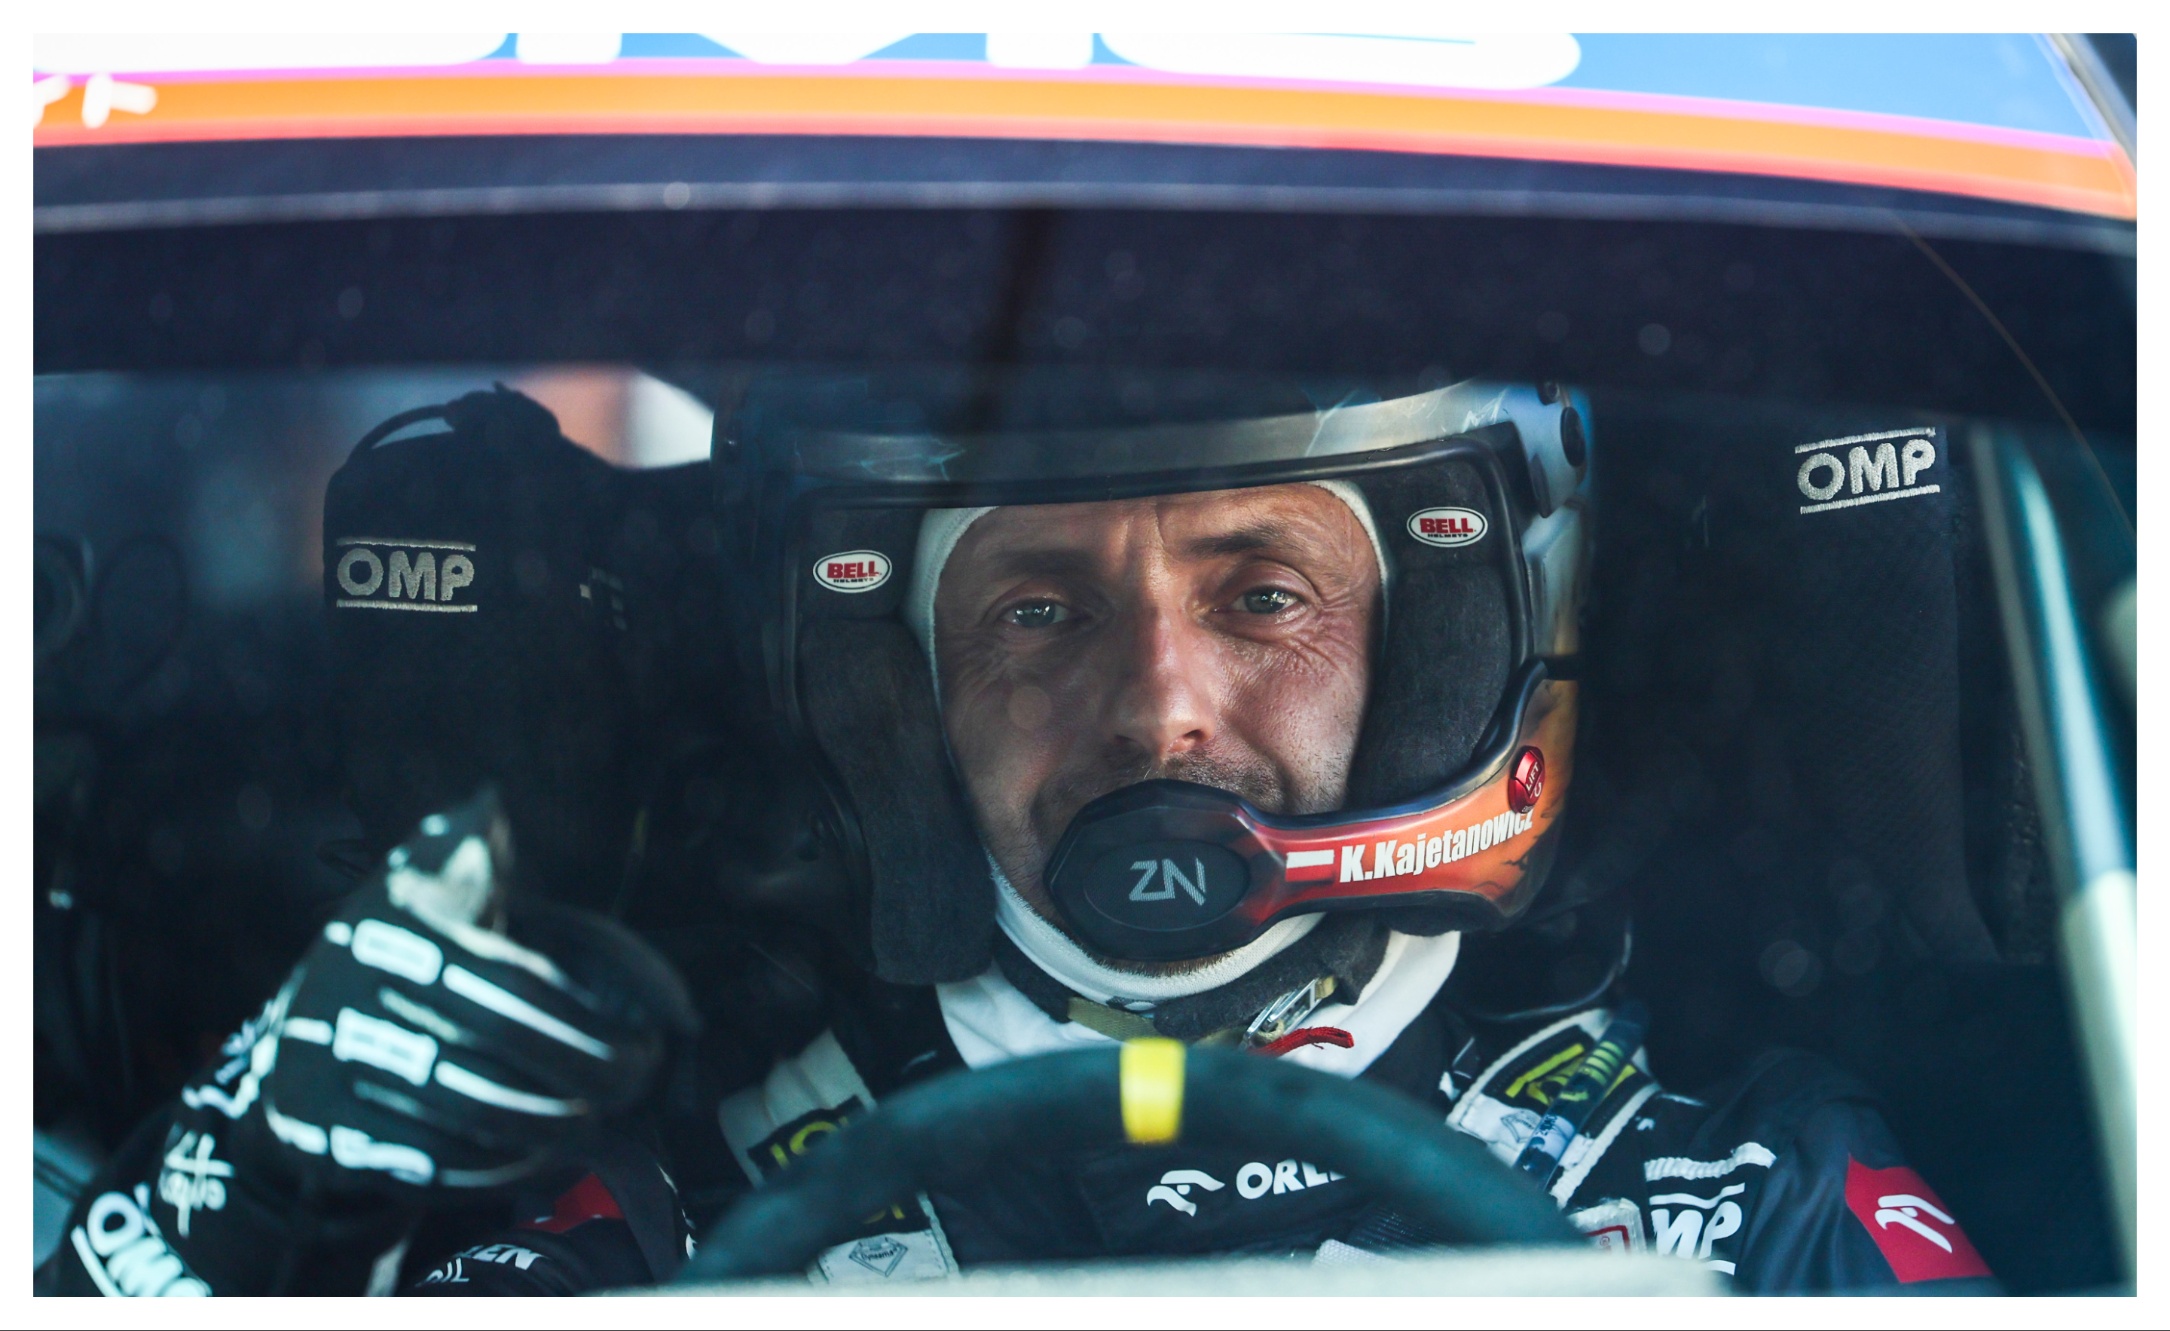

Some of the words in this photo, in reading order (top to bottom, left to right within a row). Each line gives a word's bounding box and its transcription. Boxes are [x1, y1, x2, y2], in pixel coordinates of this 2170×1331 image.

[1797, 438, 1936, 501] OMP
[1419, 517, 1474, 534] BELL
[337, 547, 475, 601] OMP
[827, 560, 880, 579] BELL
[1525, 761, 1539, 791] LIFT
[1339, 807, 1533, 883] K.Kajetanowicz
